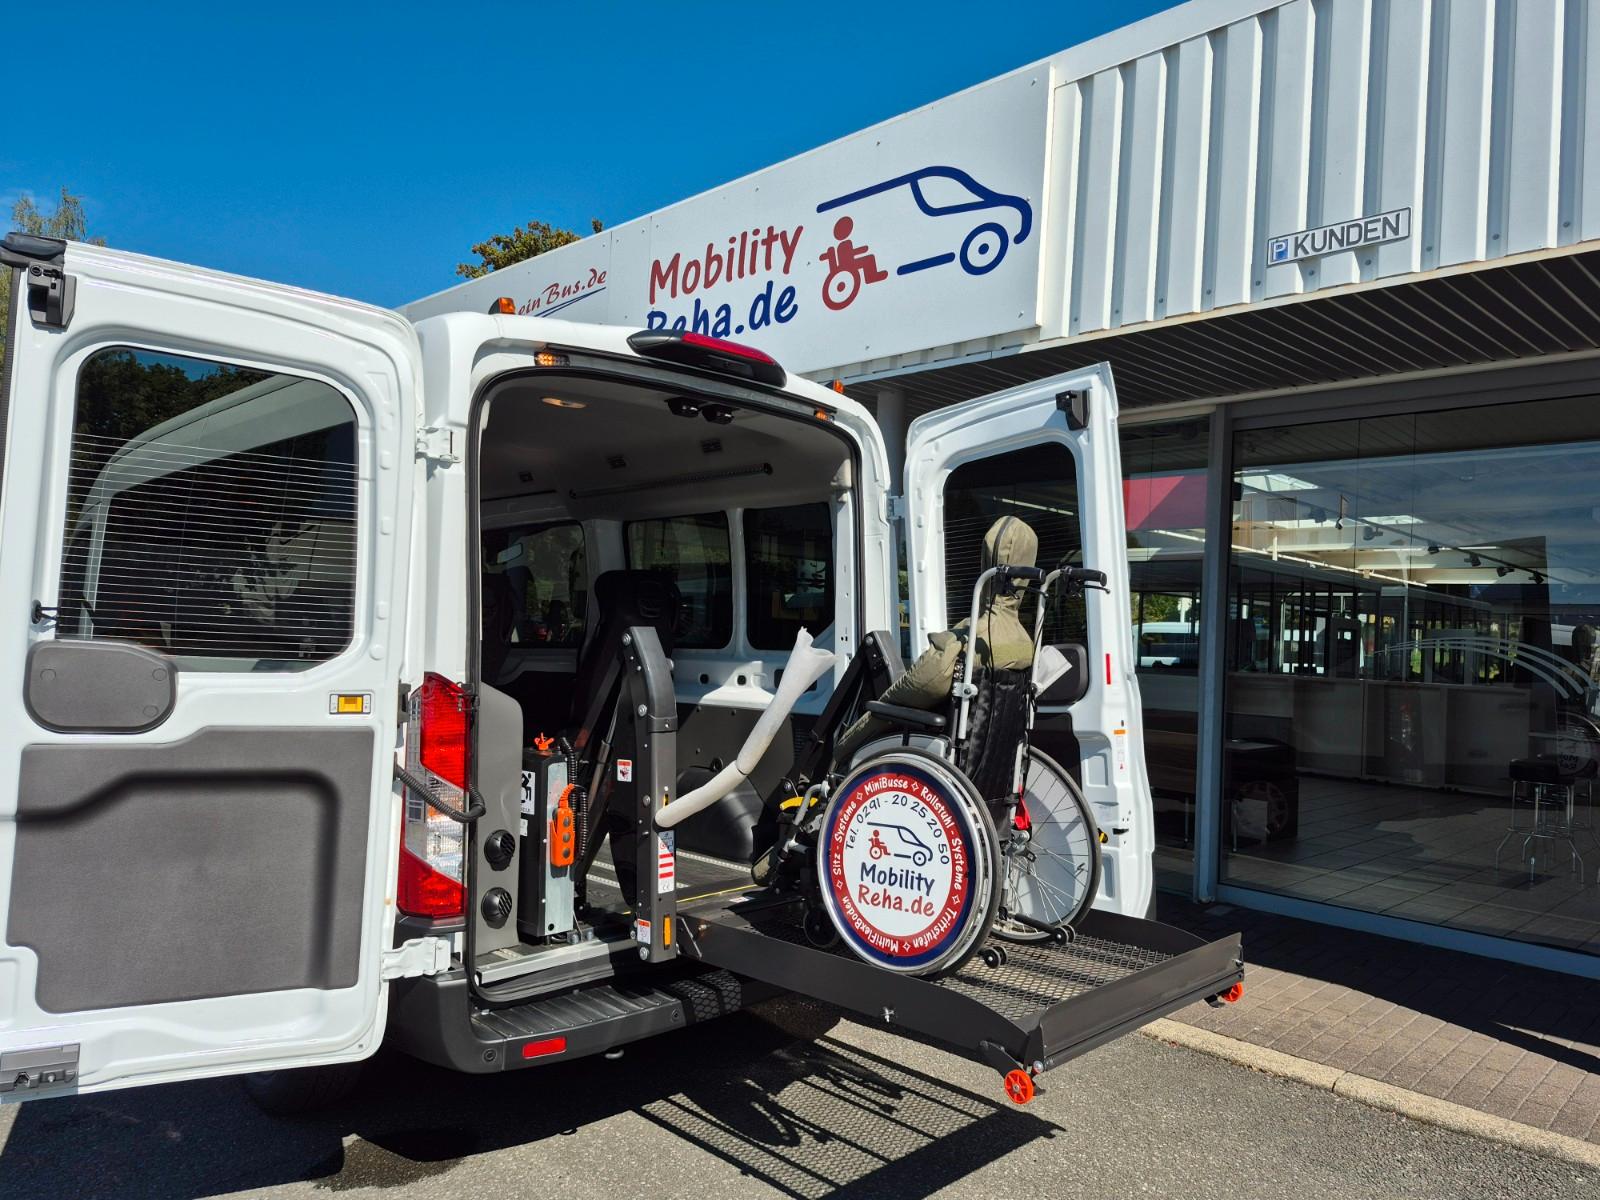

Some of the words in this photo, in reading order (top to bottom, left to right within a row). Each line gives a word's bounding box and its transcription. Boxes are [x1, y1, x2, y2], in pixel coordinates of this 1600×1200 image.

[1293, 212, 1401, 258] KUNDEN
[649, 225, 804, 305] Mobility
[517, 297, 541, 316] ein
[541, 267, 607, 305] Bus.de
[863, 776, 909, 796] MiniBusse
[834, 801, 857, 843] Systeme
[845, 828, 859, 850] Tel.
[856, 797, 881, 824] 0291
[891, 794, 908, 807] 20
[910, 801, 929, 819] 25
[926, 818, 943, 839] 20
[937, 843, 951, 865] 50
[920, 786, 955, 829] Rollstuhl
[950, 838, 967, 892] Systeme
[832, 853, 842, 876] Sitz
[860, 861, 935, 897] Mobility
[857, 884, 935, 917] Reha.de
[841, 895, 899, 953] MultiFlexBoden
[912, 908, 957, 949] Trittstufen
